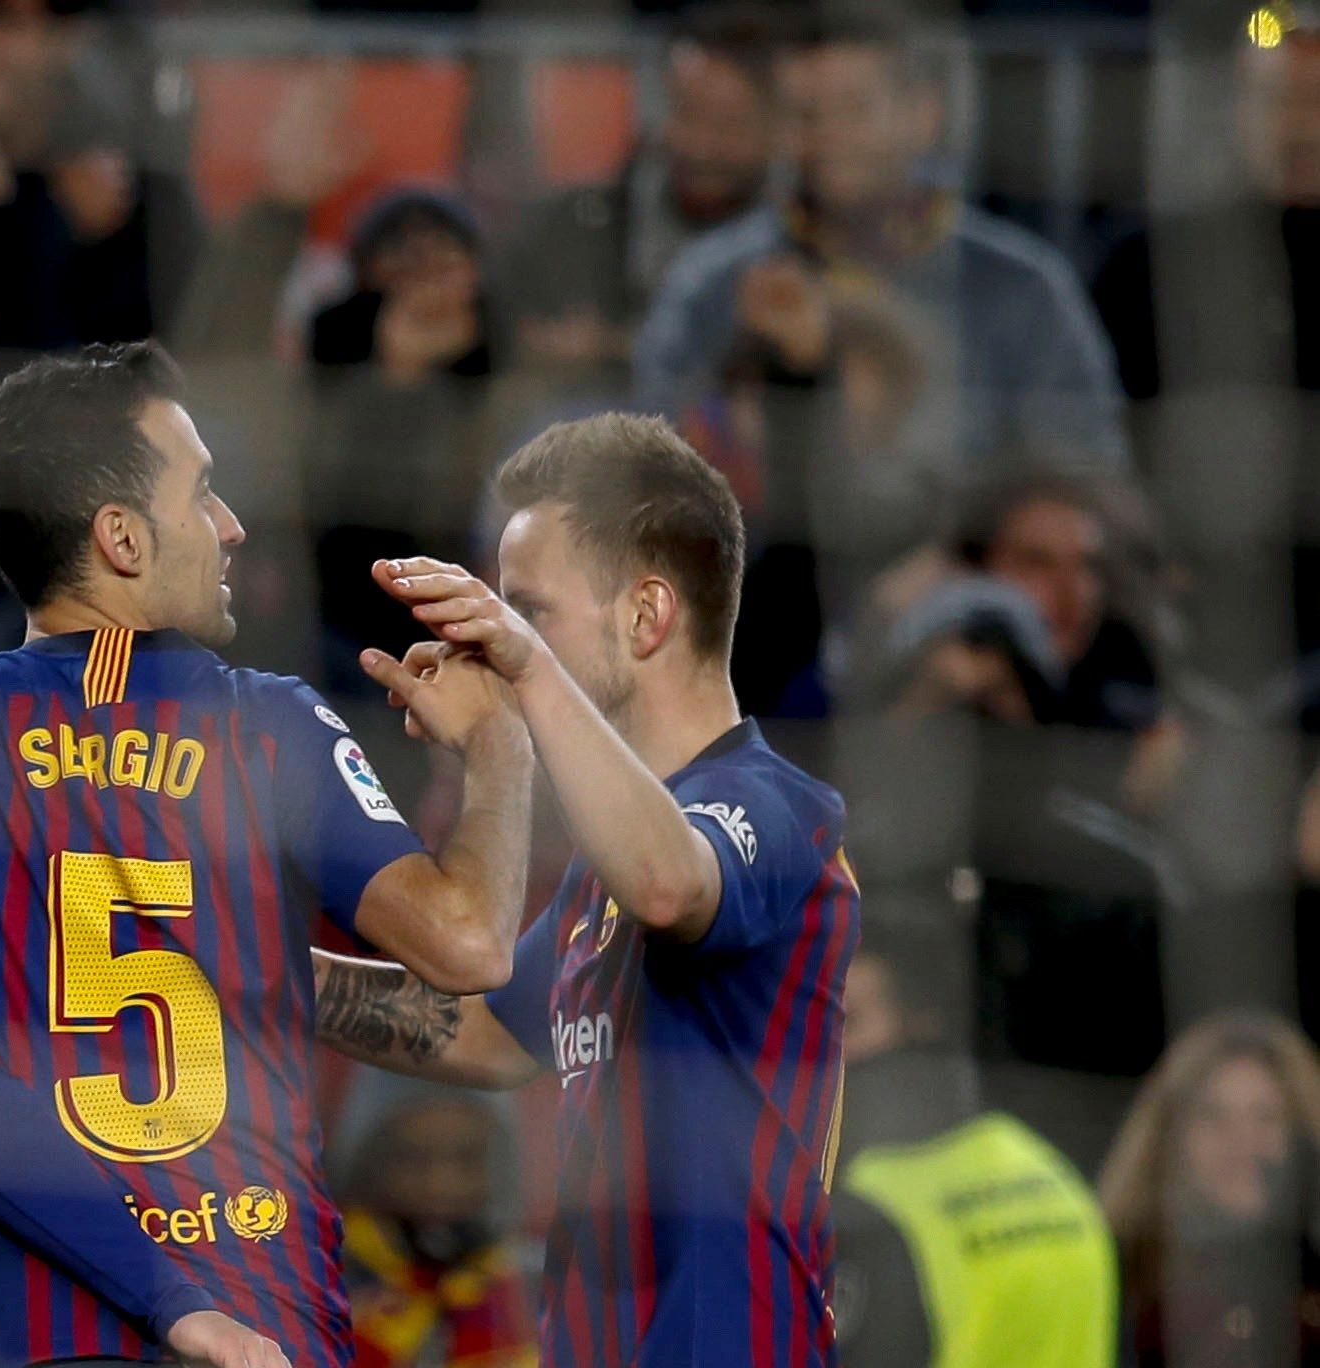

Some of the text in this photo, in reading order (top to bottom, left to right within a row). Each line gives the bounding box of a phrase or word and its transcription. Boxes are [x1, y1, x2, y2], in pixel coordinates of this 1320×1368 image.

[18, 723, 205, 799] SERGIO
[687, 801, 758, 866] eko
[48, 851, 228, 1162] 5
